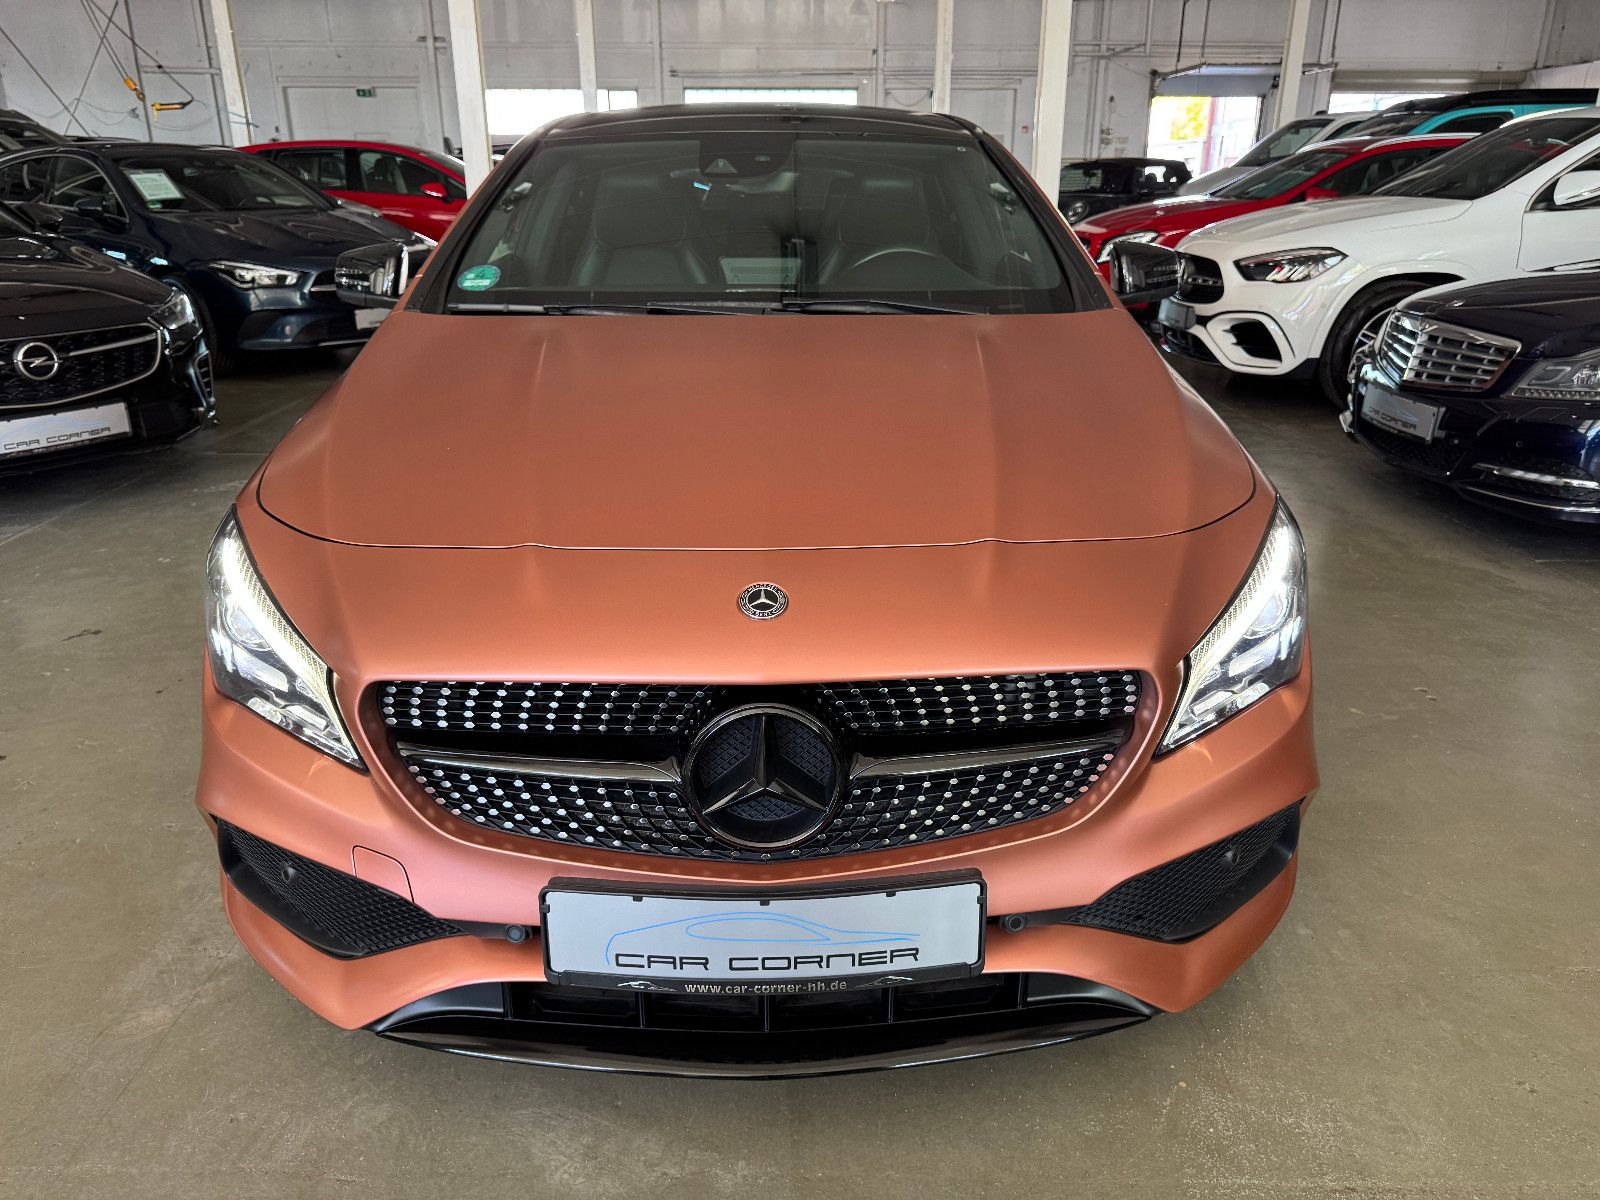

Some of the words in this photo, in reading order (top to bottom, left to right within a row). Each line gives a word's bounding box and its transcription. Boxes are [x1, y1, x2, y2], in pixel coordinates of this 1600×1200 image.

[3, 439, 40, 451] CAR
[46, 426, 111, 444] CORNER
[614, 953, 710, 971] CAR
[728, 947, 920, 971] CORNER
[684, 980, 848, 994] www.car-corner-hh.de
